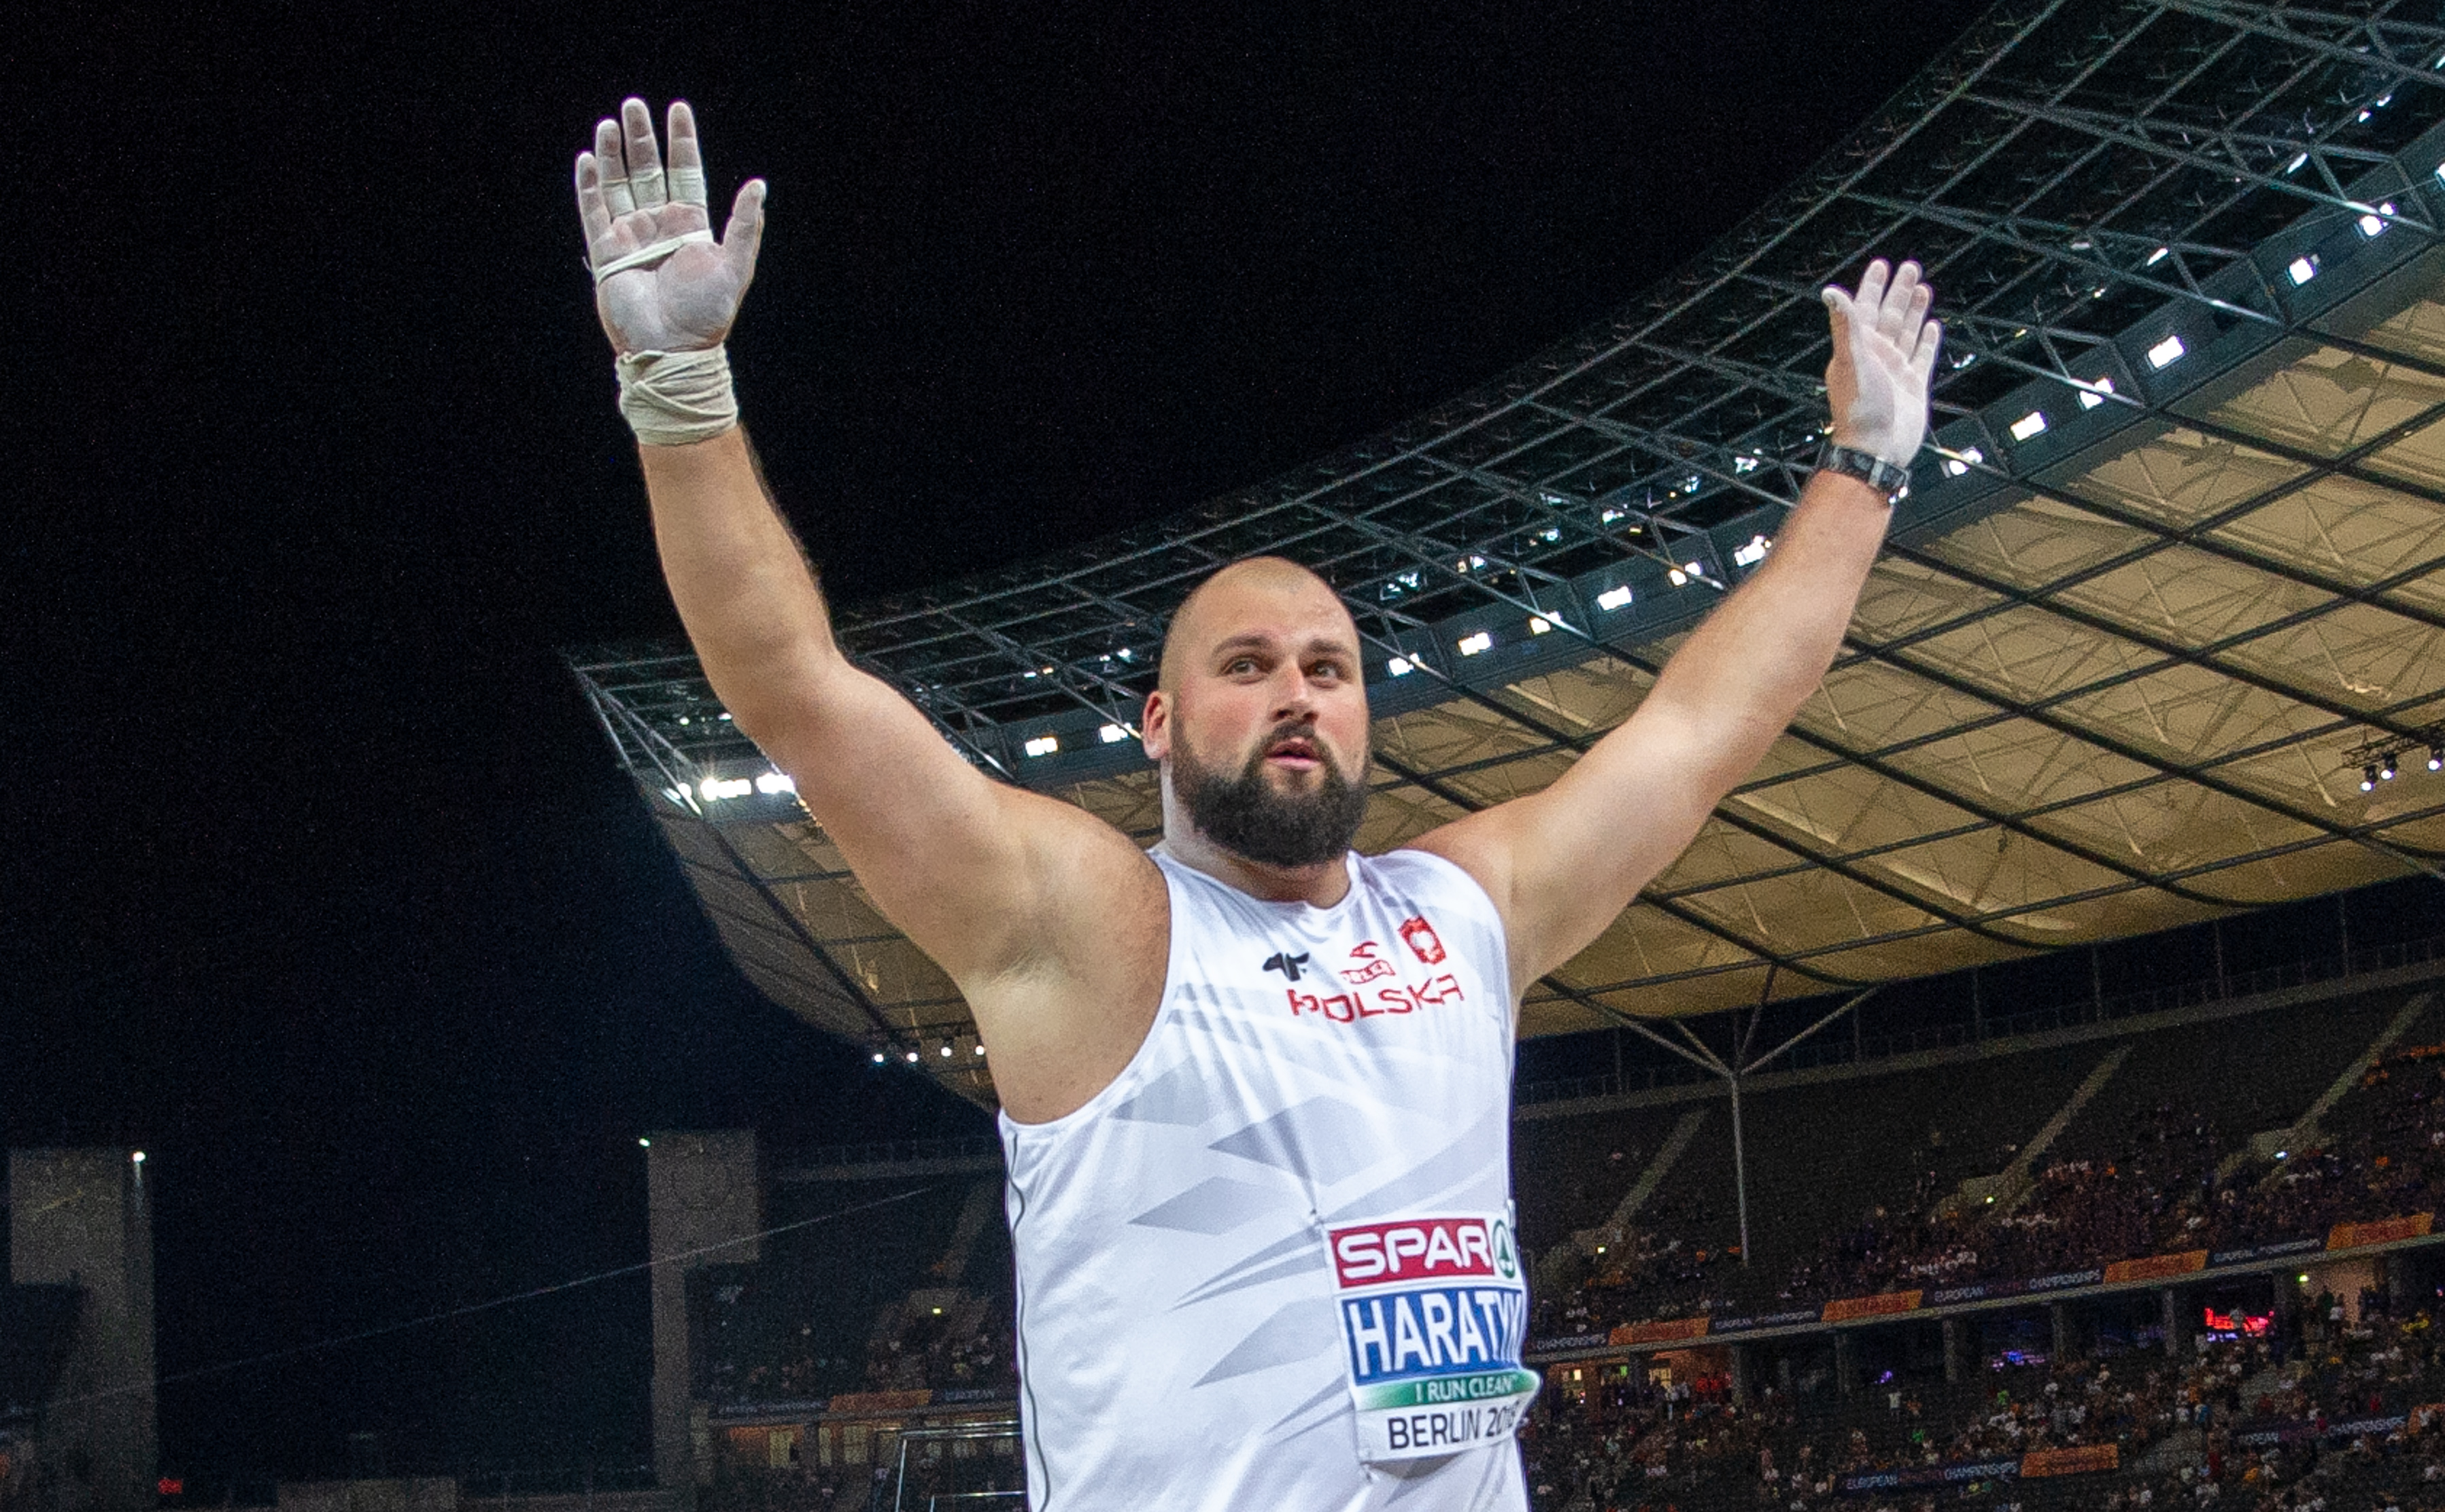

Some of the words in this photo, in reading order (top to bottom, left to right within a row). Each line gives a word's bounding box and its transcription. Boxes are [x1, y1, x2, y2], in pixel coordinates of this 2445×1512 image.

[1286, 974, 1464, 1023] POLSKA
[1337, 1225, 1492, 1279] SPAR
[1416, 1382, 1422, 1403] I
[1428, 1379, 1467, 1402] RUN
[1388, 1408, 1479, 1449] BERLIN
